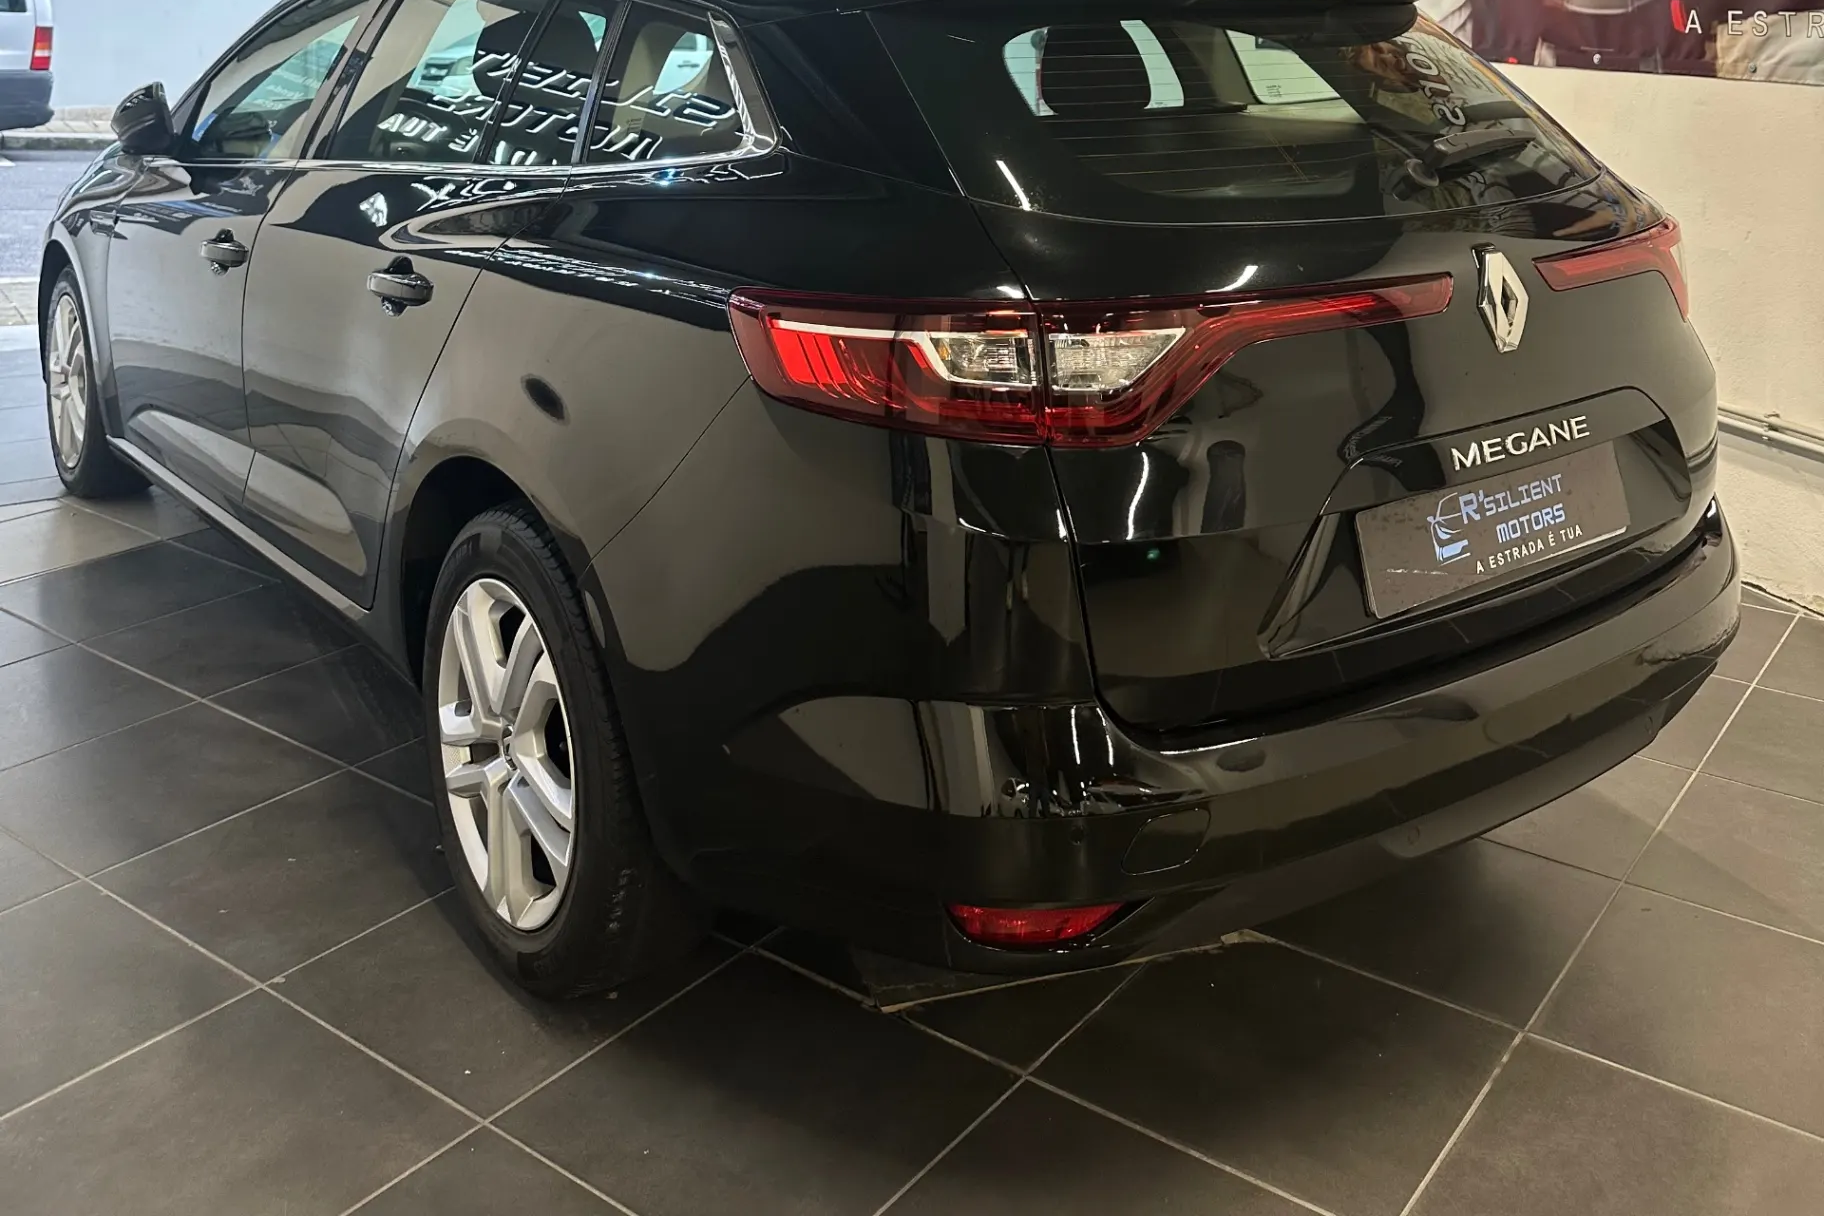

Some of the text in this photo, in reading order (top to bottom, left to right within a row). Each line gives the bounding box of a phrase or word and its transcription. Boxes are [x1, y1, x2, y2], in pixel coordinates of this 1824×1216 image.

[1684, 9, 1703, 35] A
[1450, 415, 1590, 471] MEGANE
[1459, 473, 1562, 524] R'SILIENT
[1496, 503, 1566, 544] MOTORS
[1476, 524, 1583, 574] A ESTRADA É TUA
